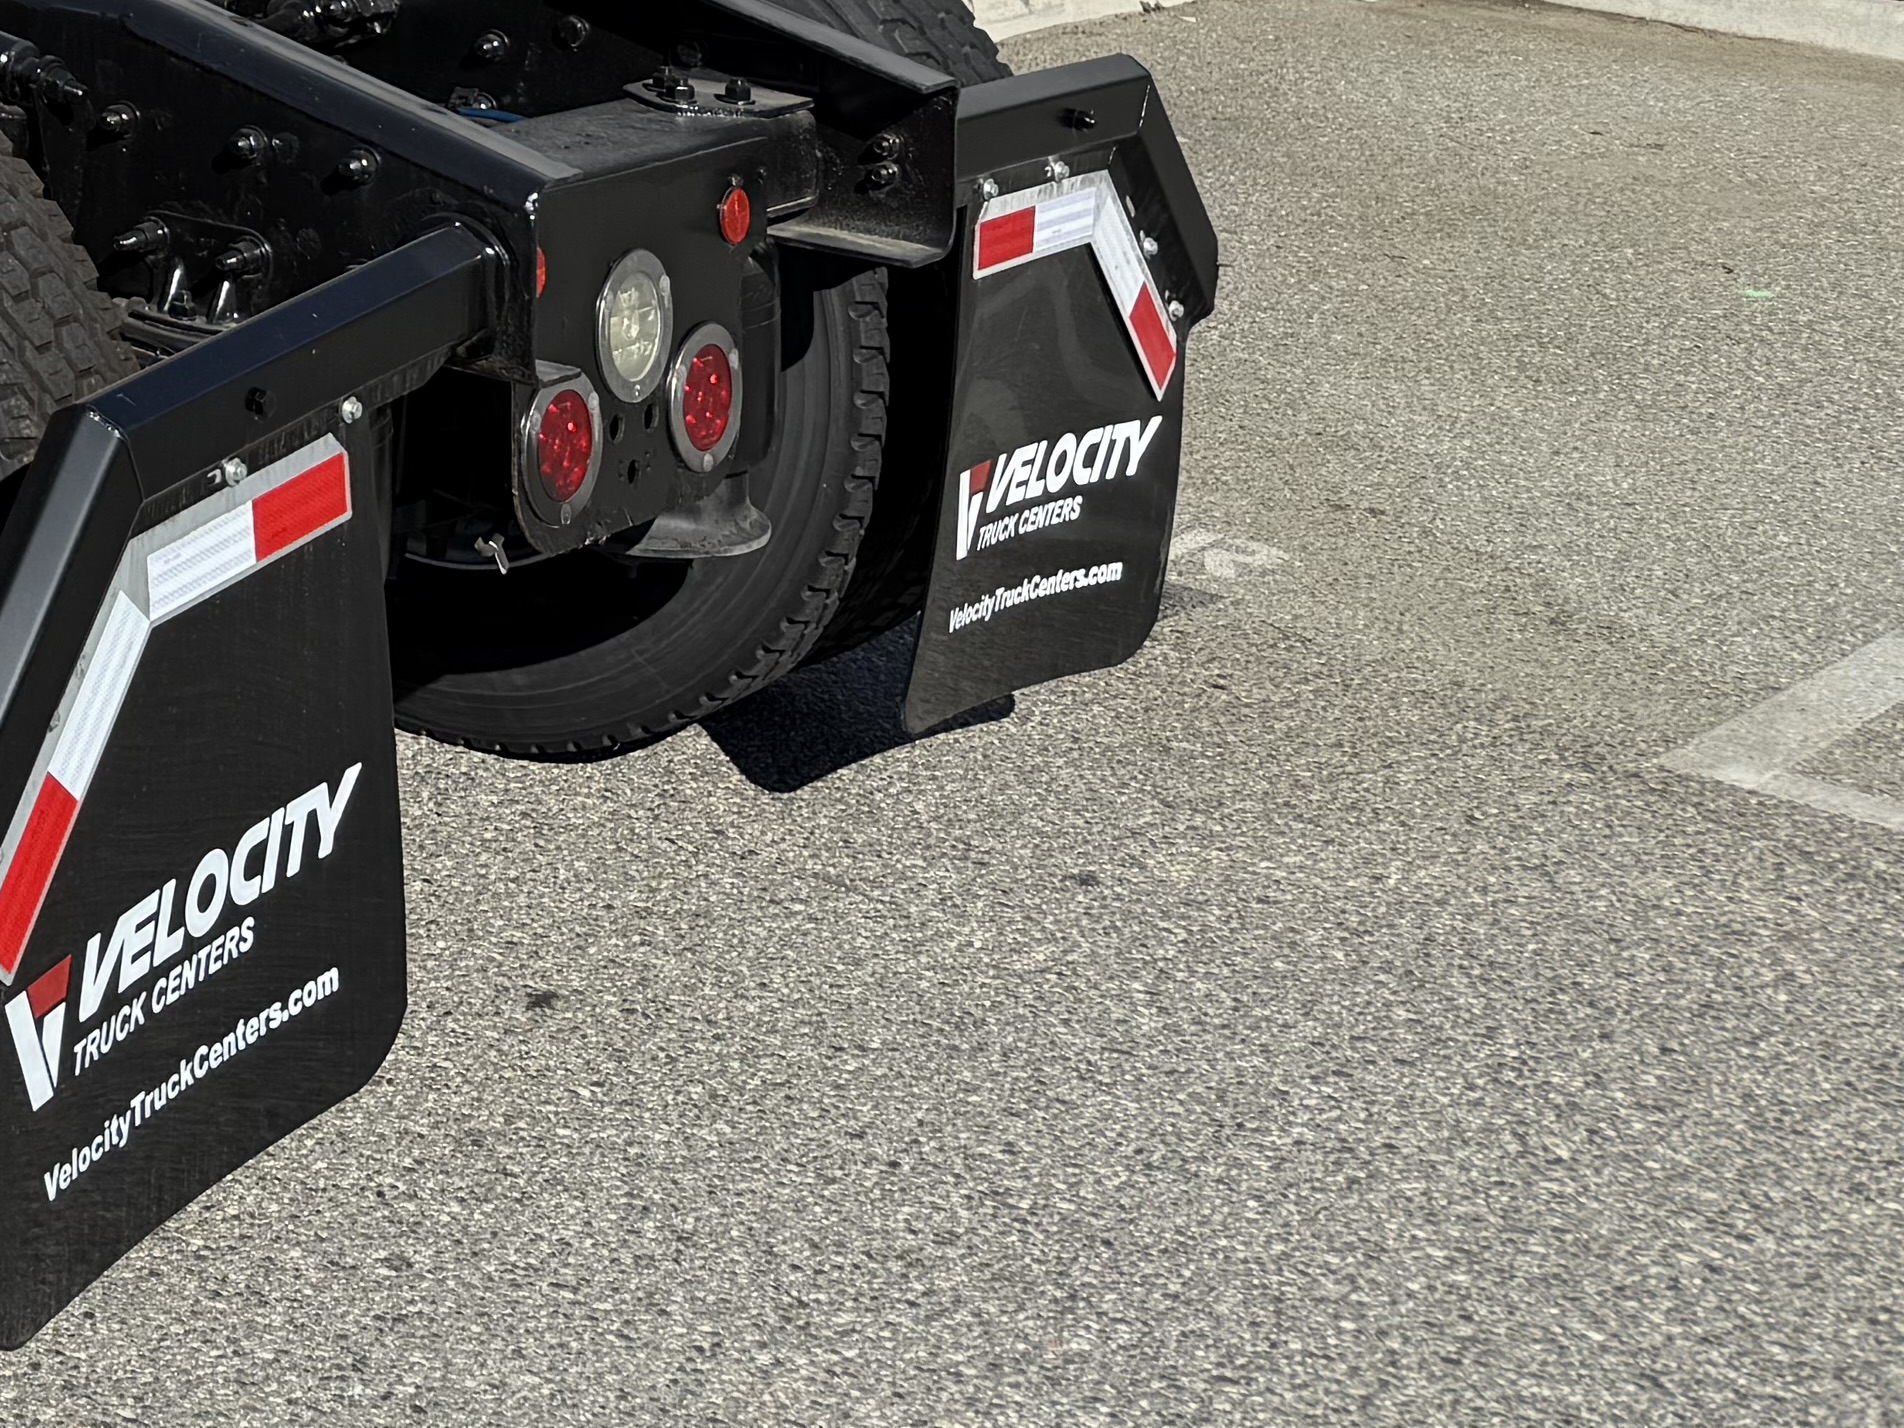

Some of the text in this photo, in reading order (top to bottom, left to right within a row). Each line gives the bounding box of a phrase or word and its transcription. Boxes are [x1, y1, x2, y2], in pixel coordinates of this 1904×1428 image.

[977, 495, 1083, 551] TRUCK CENTERS
[986, 415, 1163, 514] VELOCITY
[949, 561, 1123, 633] VelocityTruckCenters.com
[78, 762, 362, 1022] VELOCITY
[73, 916, 255, 1076] TRUCK CENTERS
[43, 965, 340, 1202] VelocityTruckCenters.com
